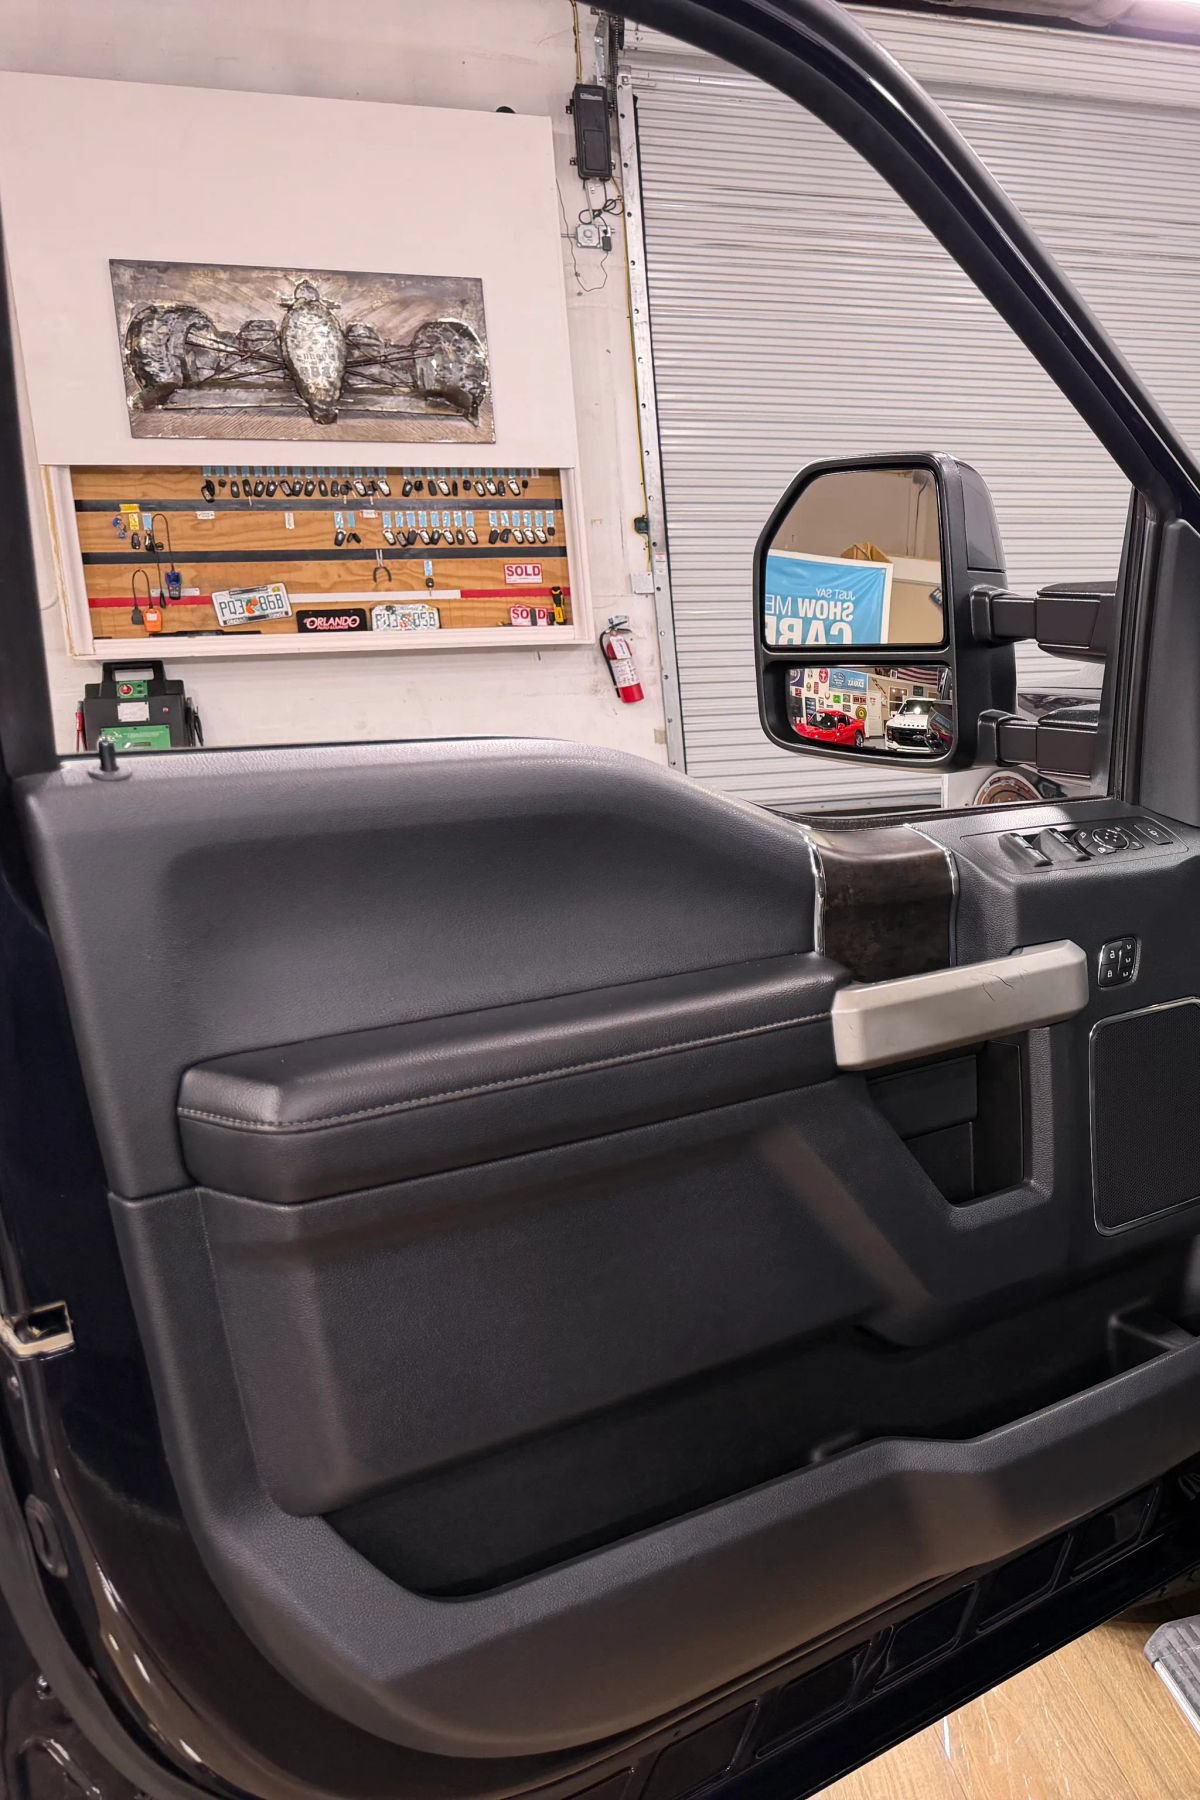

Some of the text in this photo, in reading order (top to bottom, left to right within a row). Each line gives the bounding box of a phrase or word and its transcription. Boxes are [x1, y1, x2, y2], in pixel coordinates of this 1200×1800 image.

[506, 565, 541, 577] SOLD
[511, 608, 546, 620] SOD
[306, 615, 360, 629] ORLANDO
